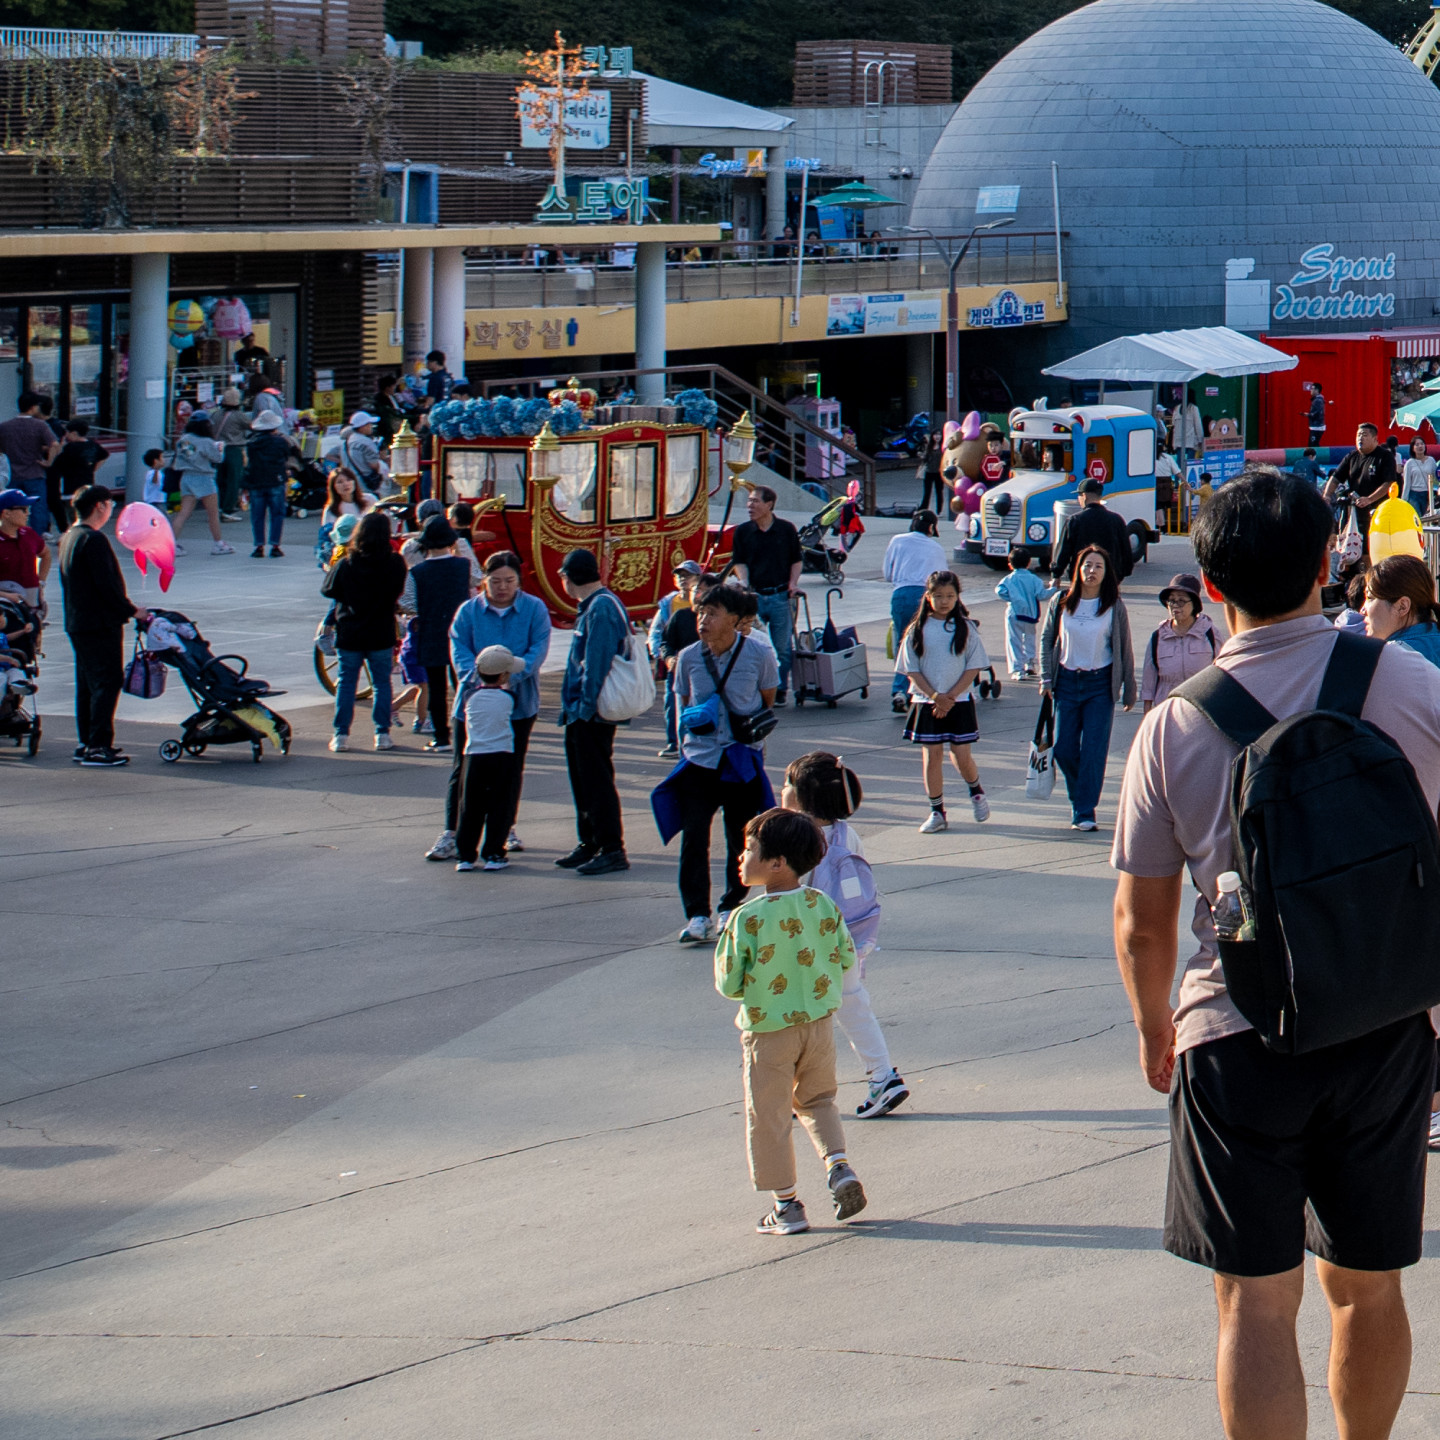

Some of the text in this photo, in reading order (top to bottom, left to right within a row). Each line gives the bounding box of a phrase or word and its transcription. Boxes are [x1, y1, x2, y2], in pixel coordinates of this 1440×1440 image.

[584, 46, 633, 76] 카페
[536, 178, 643, 225] 스토어
[1289, 243, 1396, 293] Spout
[969, 307, 994, 326] 게임
[1023, 303, 1045, 322] 캠프
[473, 319, 563, 350] 화장실
